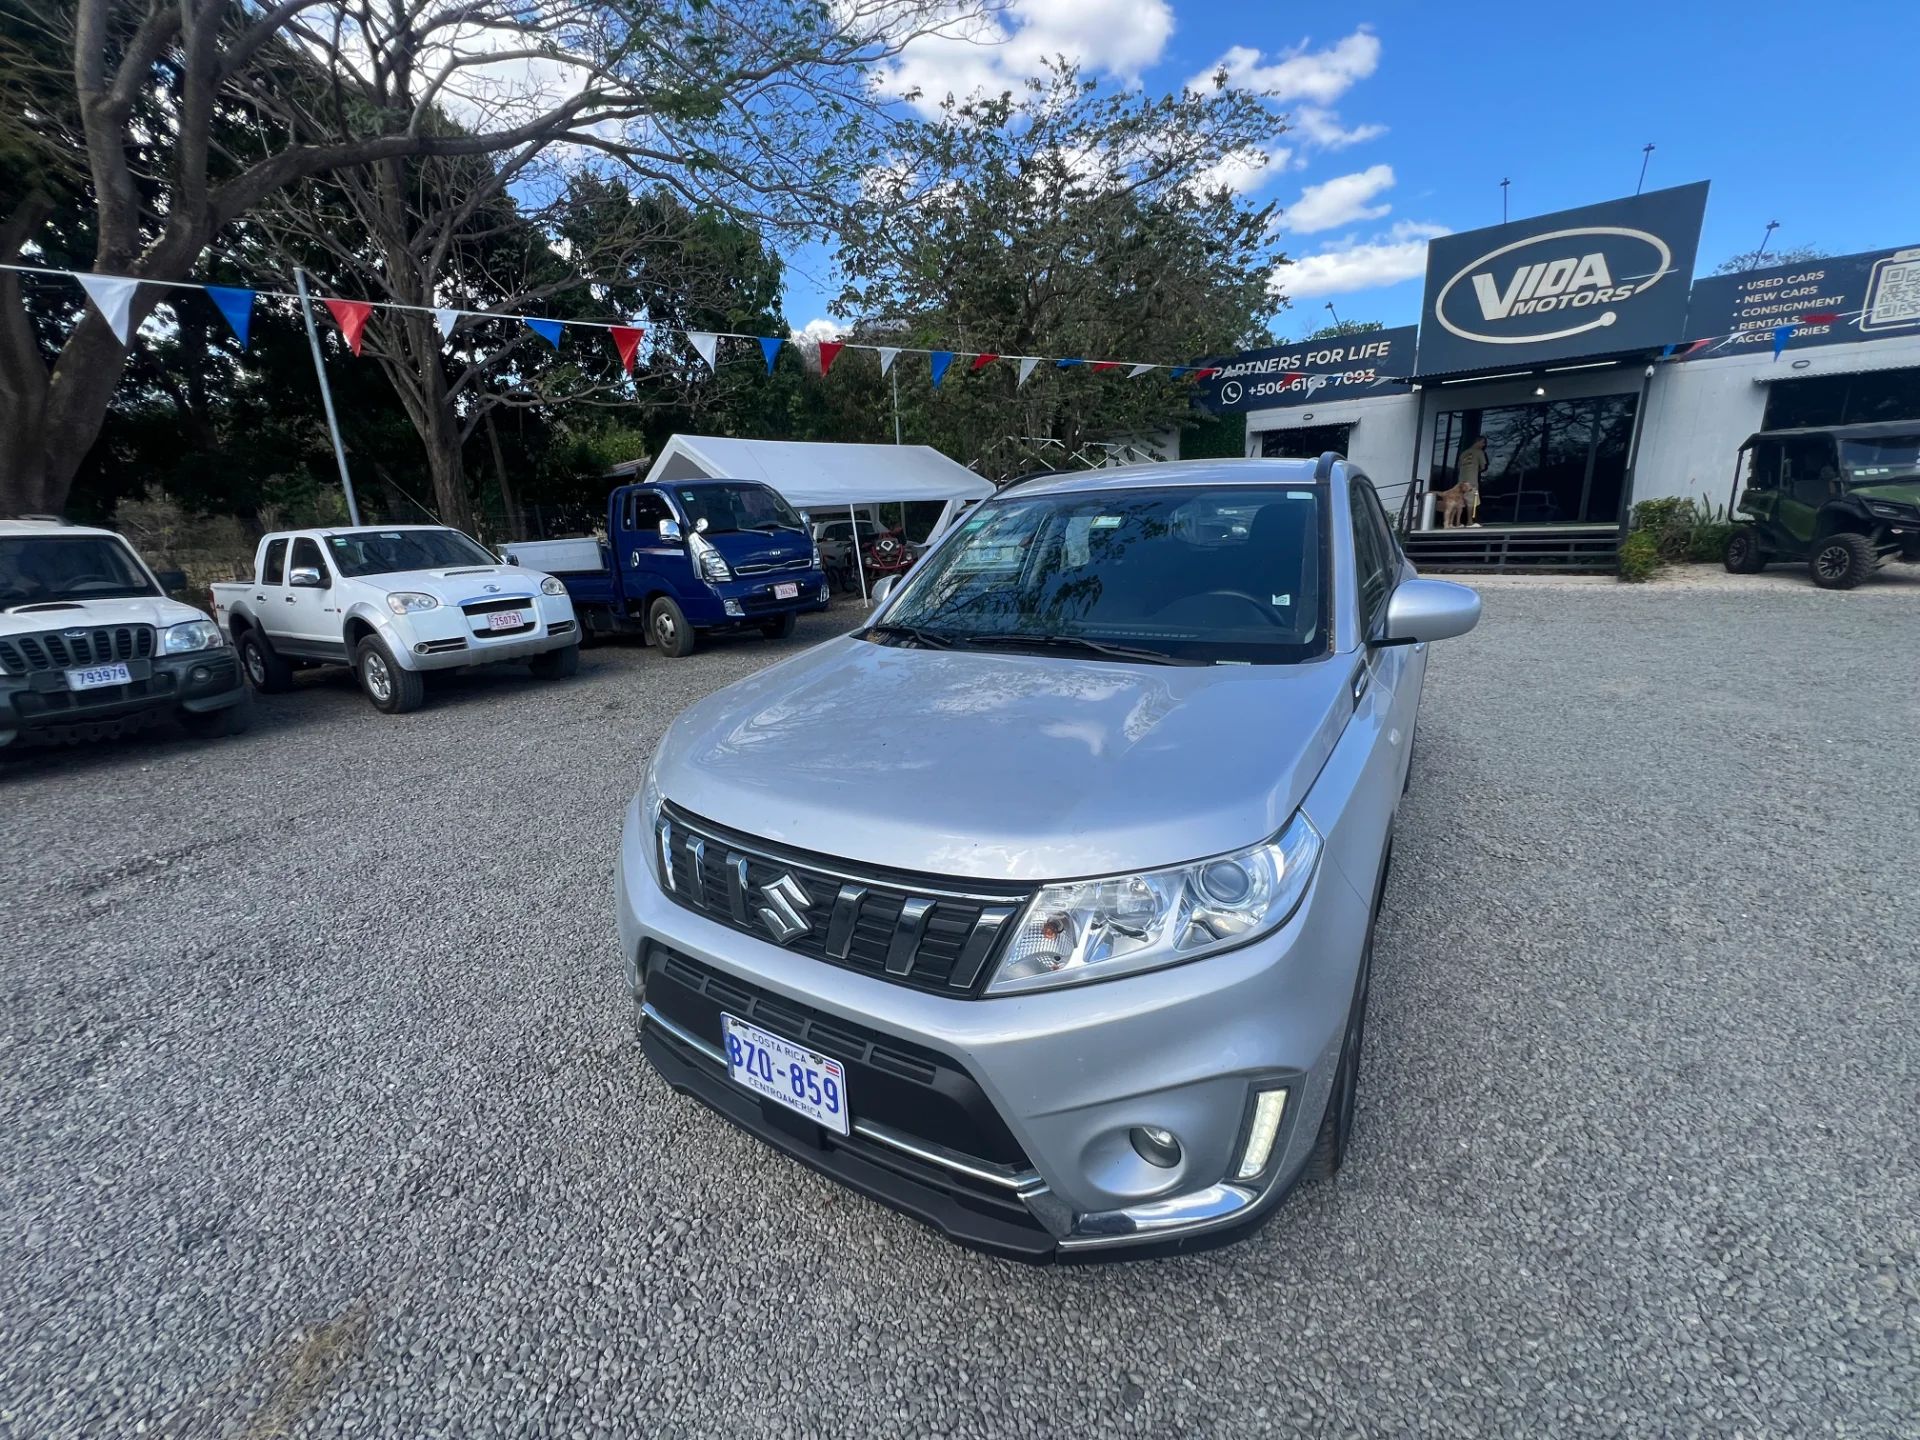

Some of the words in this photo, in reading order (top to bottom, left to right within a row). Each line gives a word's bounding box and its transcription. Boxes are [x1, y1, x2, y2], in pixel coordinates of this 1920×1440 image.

[1471, 252, 1612, 321] VIDA
[1747, 277, 1784, 290] USED
[1787, 270, 1825, 284] CARS
[1510, 284, 1636, 317] MOTORS
[1741, 295, 1845, 317] CONSIGNMENT
[1744, 291, 1778, 304] NEW
[1780, 285, 1819, 299] CARS
[1739, 315, 1800, 331] RENTALS
[1211, 354, 1302, 380] PARTNERS
[1305, 348, 1344, 367] FOR
[1348, 341, 1392, 361] LIFE
[78, 668, 127, 685] 793979
[752, 1033, 782, 1053] COSTA
[785, 1047, 807, 1064] RICA
[748, 1077, 823, 1120] CENTROAMERICA
